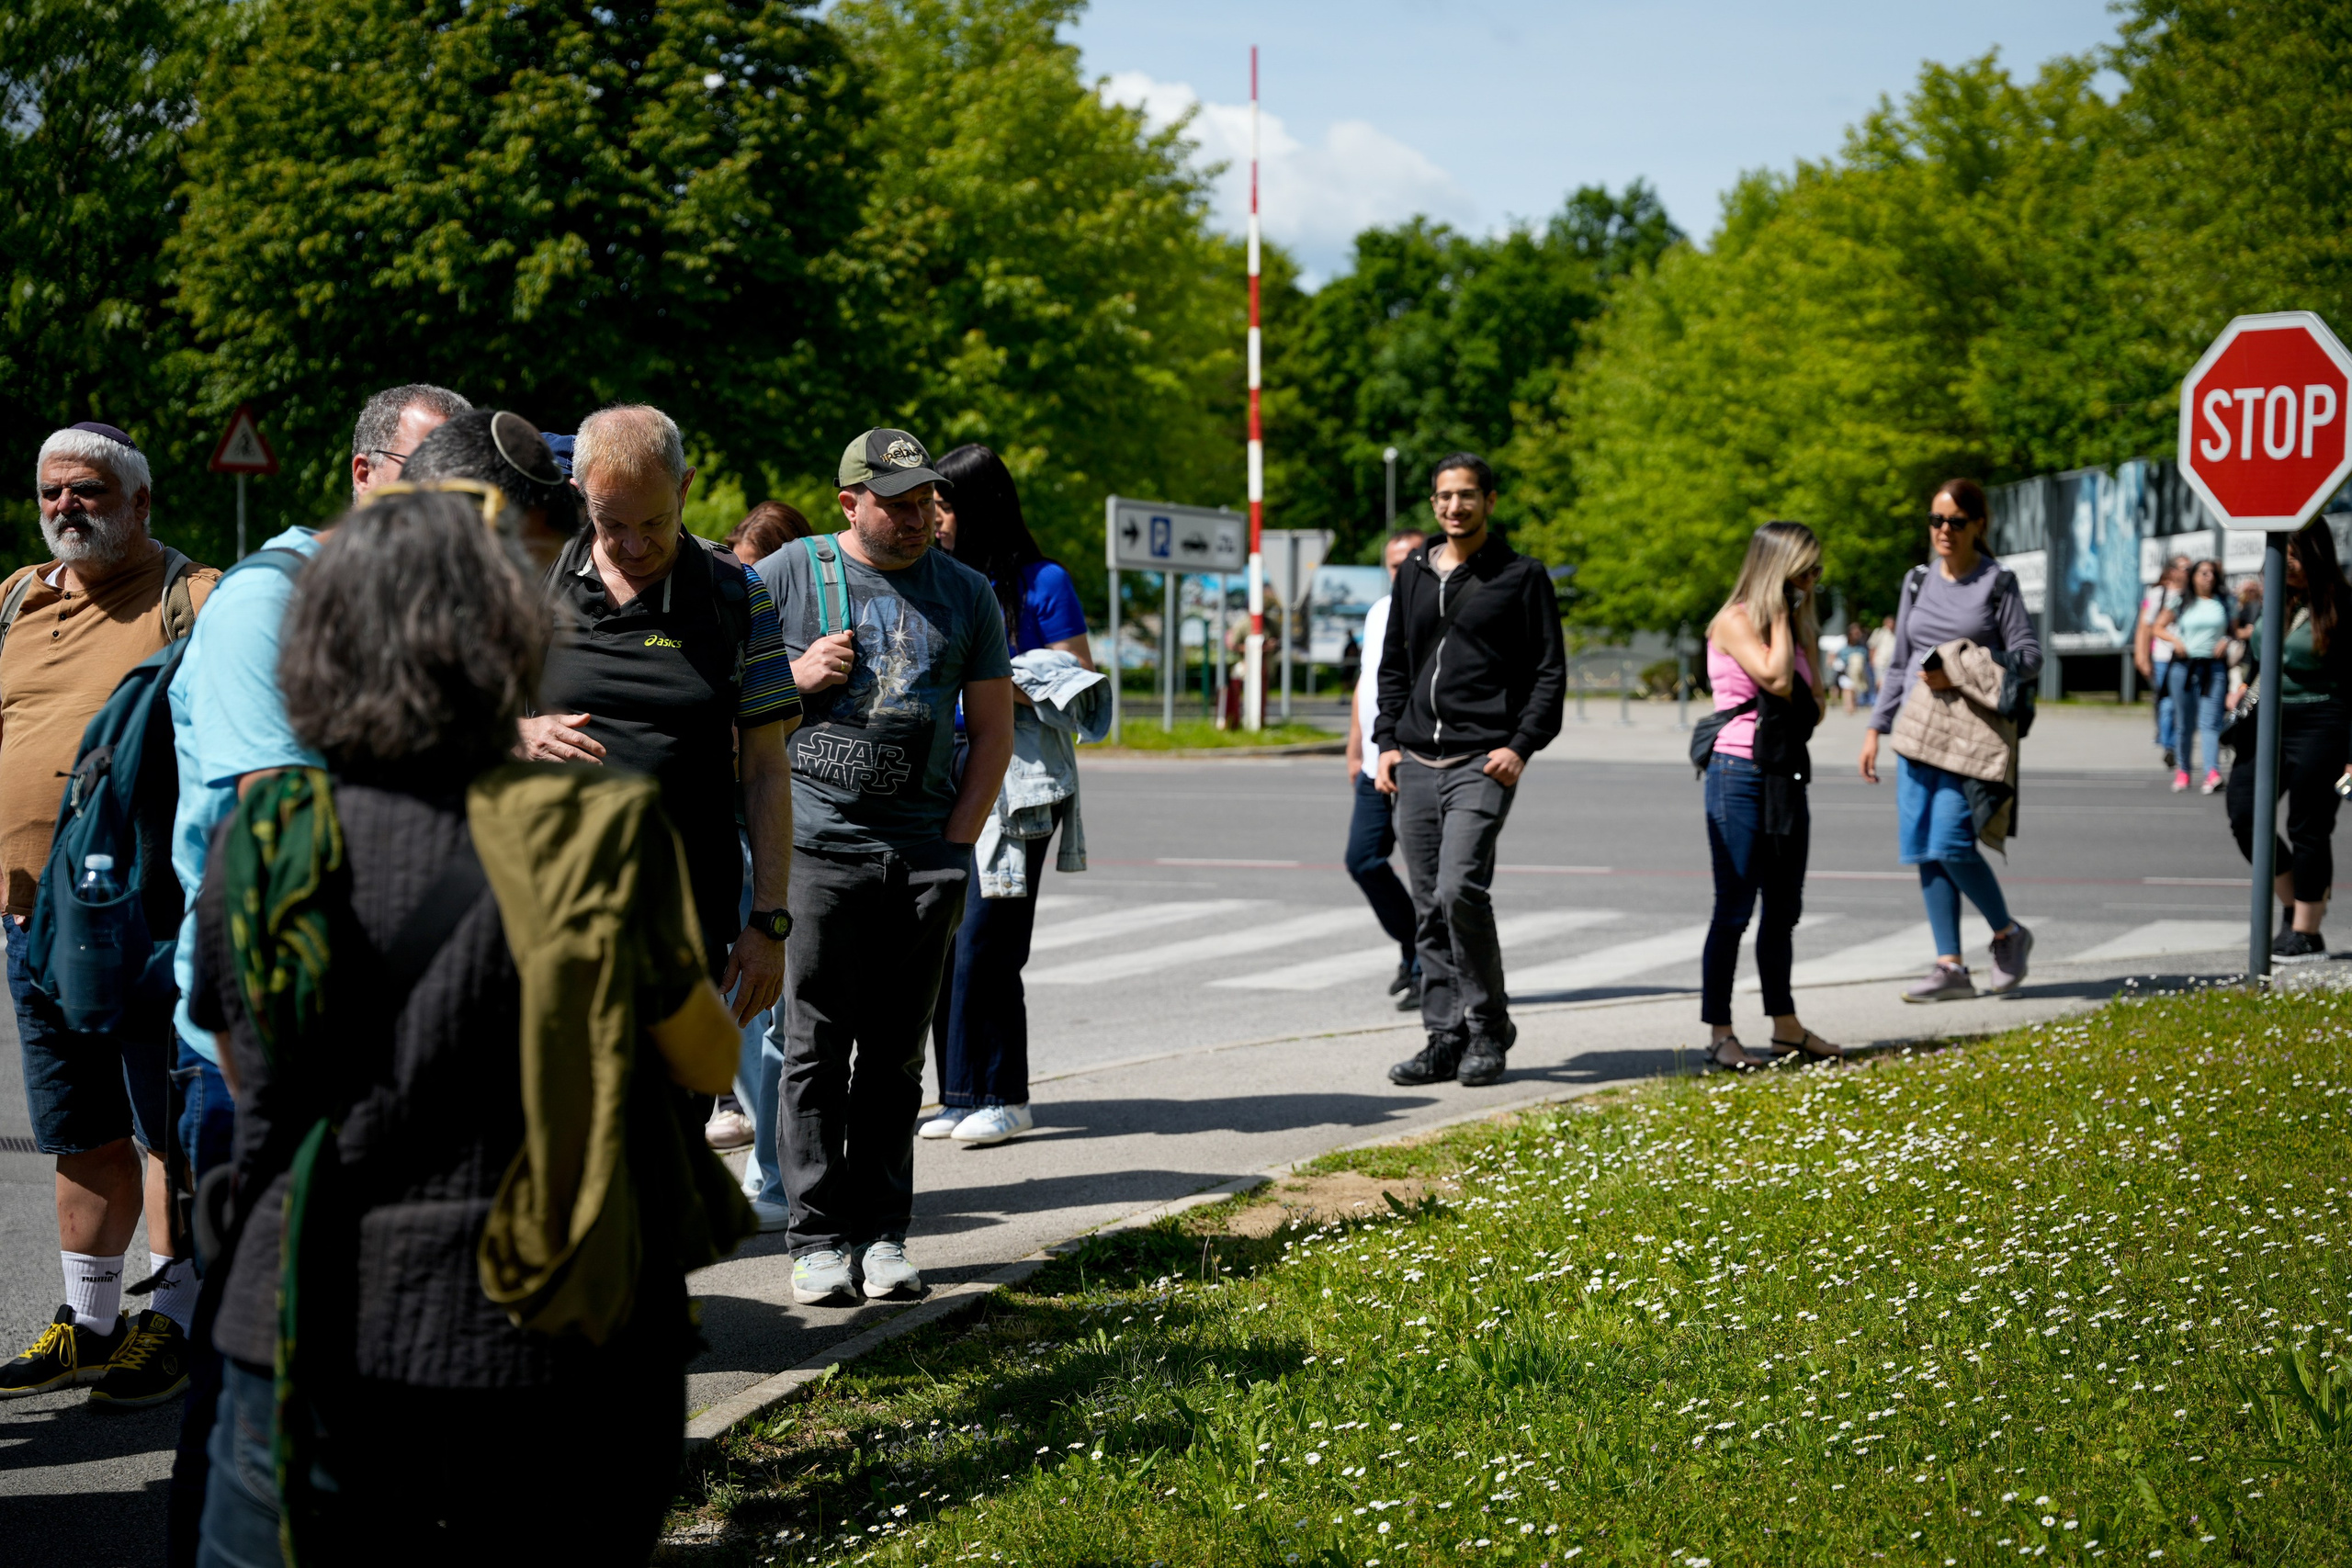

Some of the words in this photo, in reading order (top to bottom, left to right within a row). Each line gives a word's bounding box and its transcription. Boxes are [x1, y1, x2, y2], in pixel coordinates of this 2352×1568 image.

[2199, 383, 2337, 463] STOP
[797, 731, 911, 773] STAR
[797, 753, 909, 795] WARS
[81, 1275, 114, 1283] PUMA
